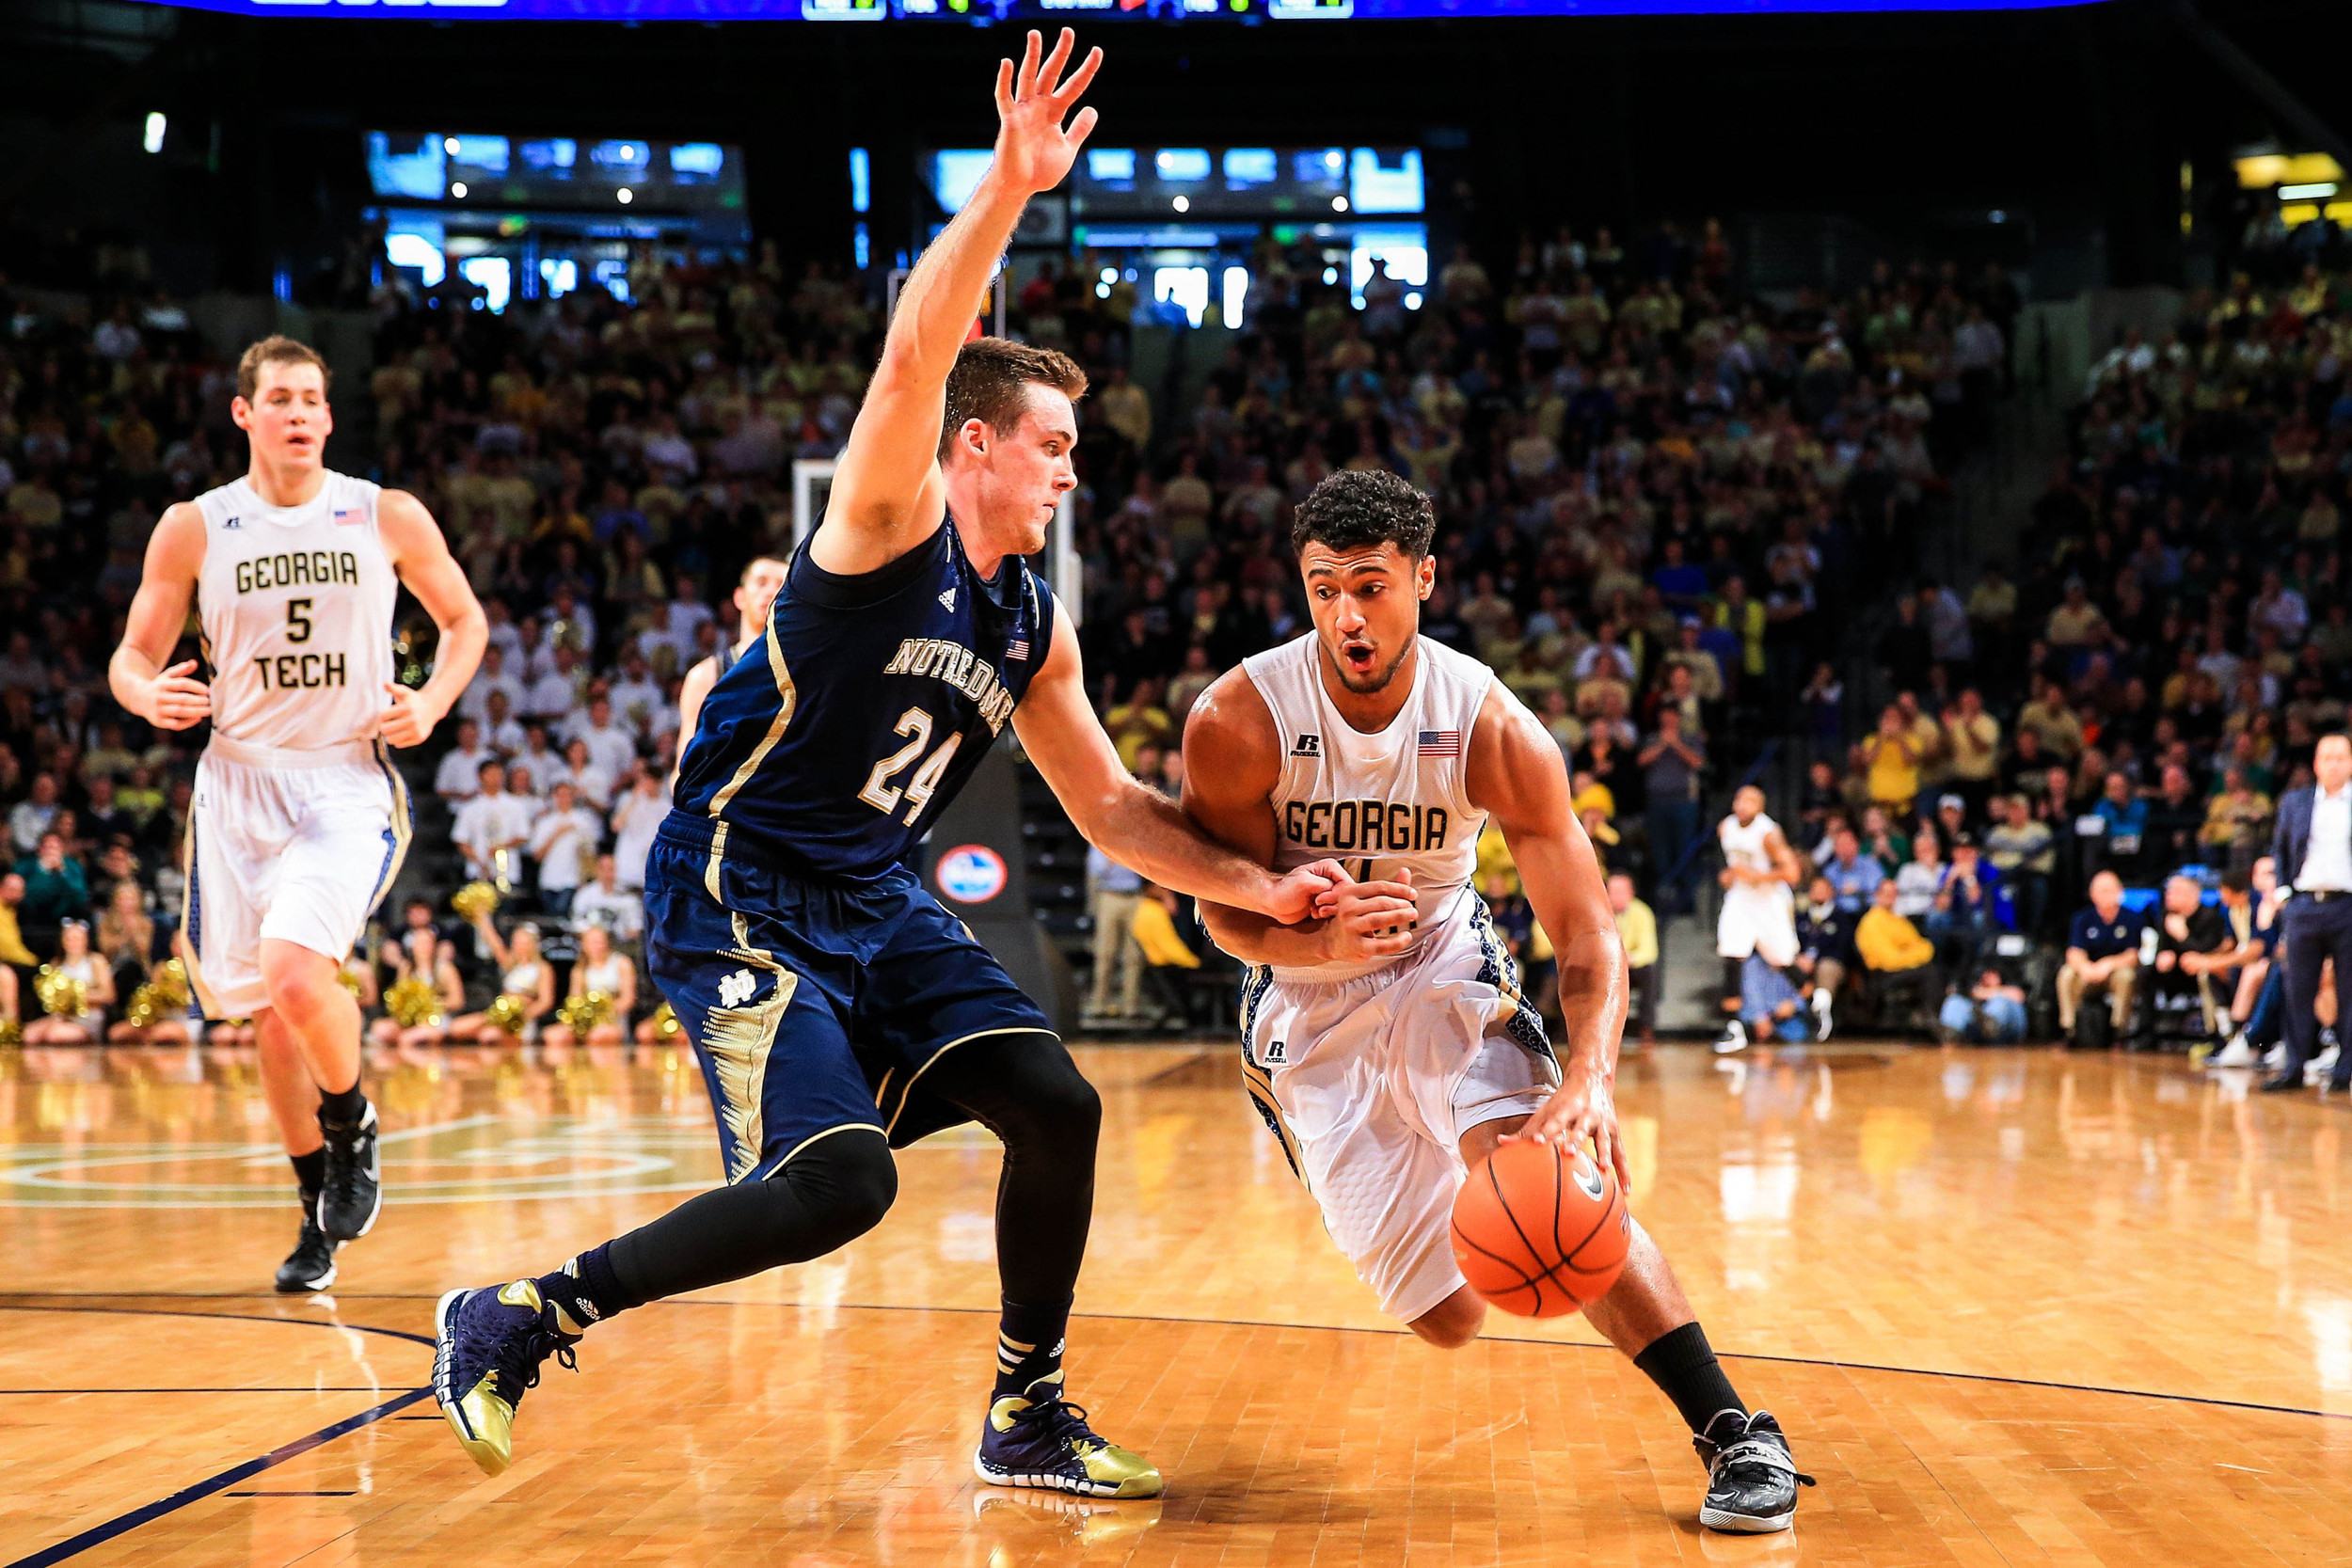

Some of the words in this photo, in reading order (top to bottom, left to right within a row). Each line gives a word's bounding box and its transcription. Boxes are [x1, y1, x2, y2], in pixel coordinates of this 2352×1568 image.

[235, 549, 358, 594] GEORGIA
[285, 596, 313, 644] 5
[253, 653, 346, 690] TECH
[857, 705, 963, 828] 24
[1286, 800, 1448, 851] GEORGIA
